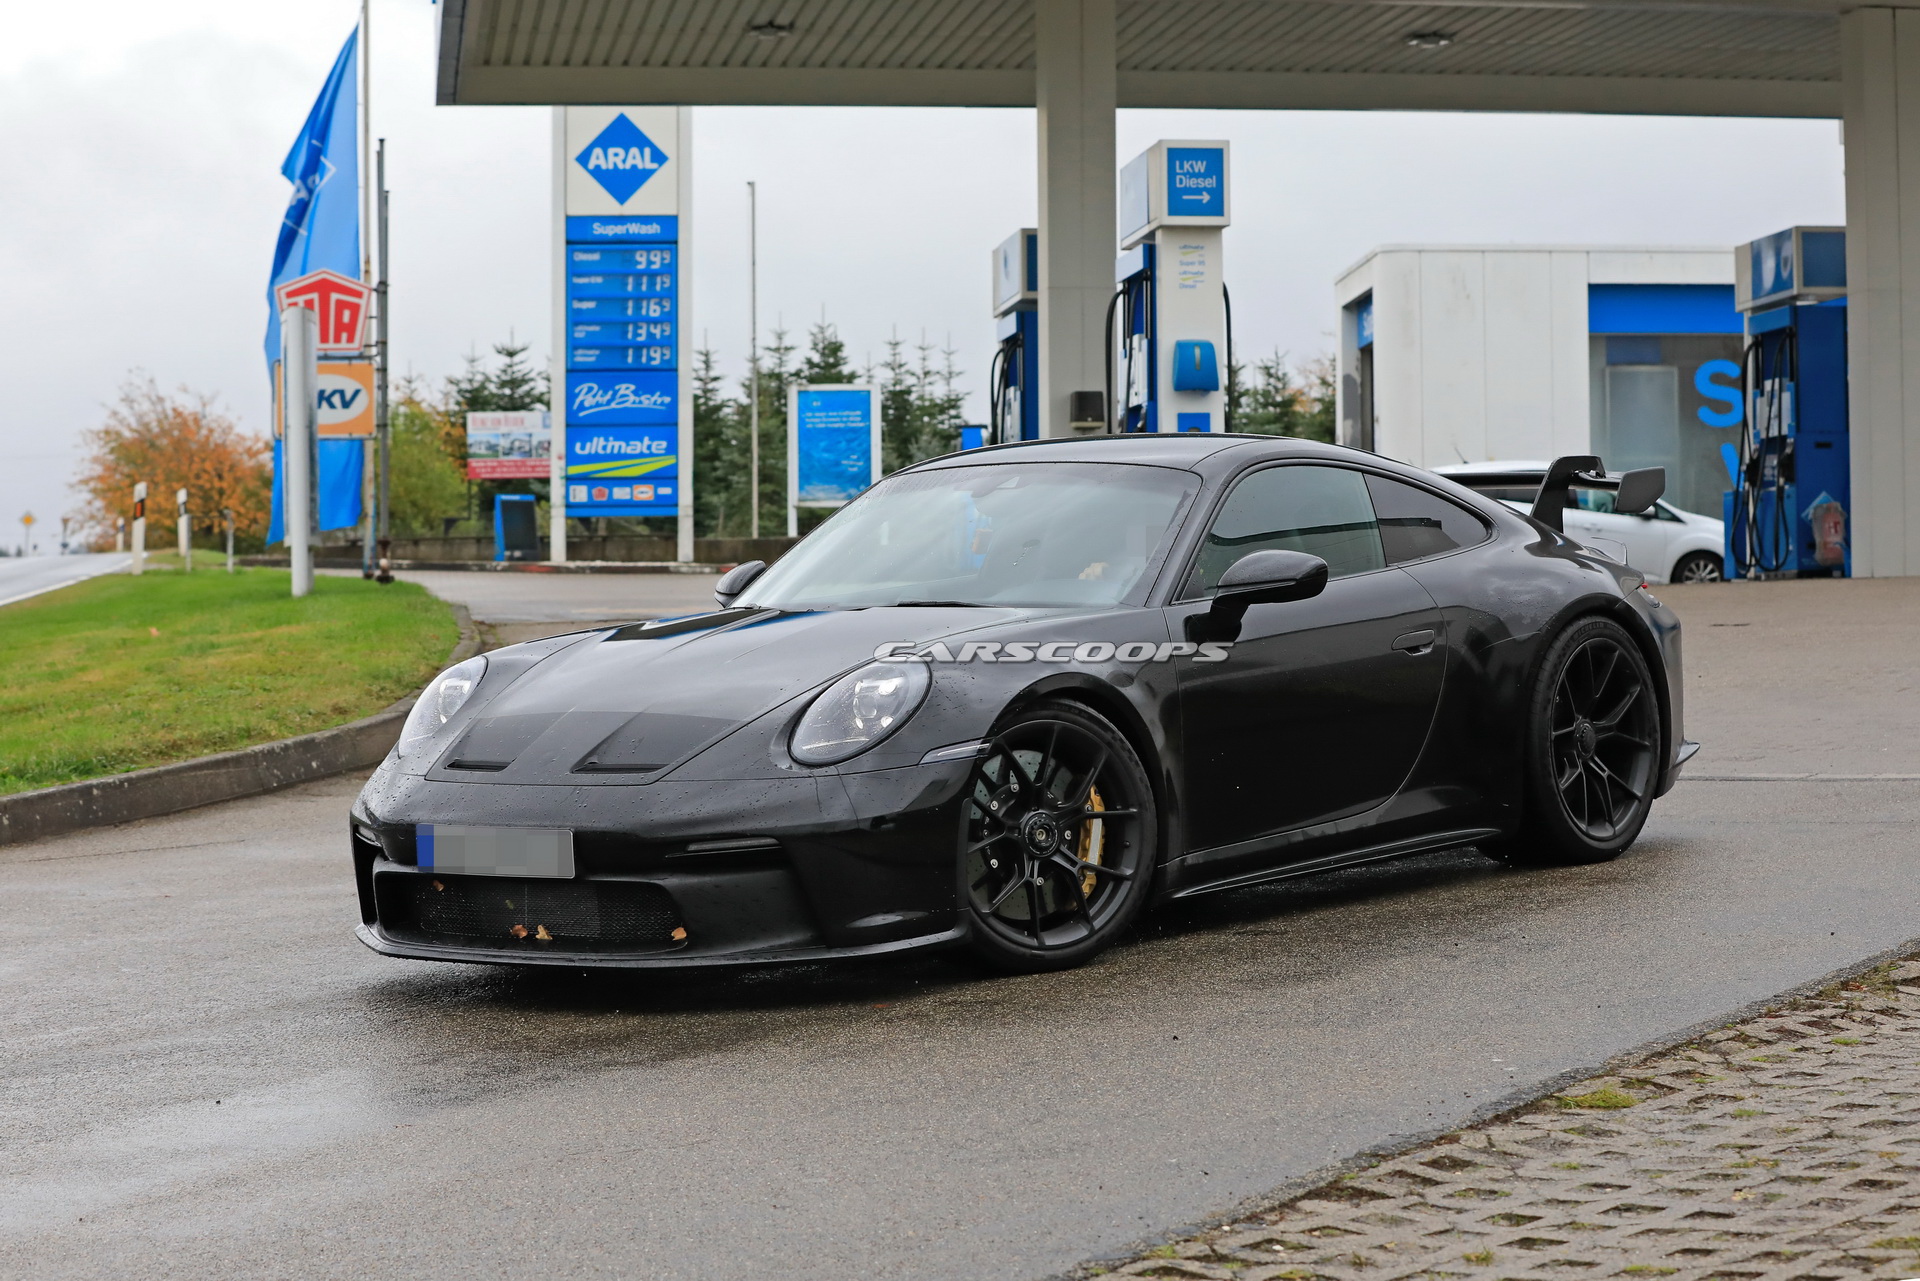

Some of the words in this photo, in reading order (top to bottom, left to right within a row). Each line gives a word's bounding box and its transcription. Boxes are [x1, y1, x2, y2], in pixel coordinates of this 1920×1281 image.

[587, 147, 660, 170] ARAL
[1175, 160, 1207, 173] LKW
[1175, 174, 1217, 188] Diesel
[592, 222, 661, 237] SuperWash
[317, 388, 361, 410] KV
[575, 436, 668, 455] ultimate
